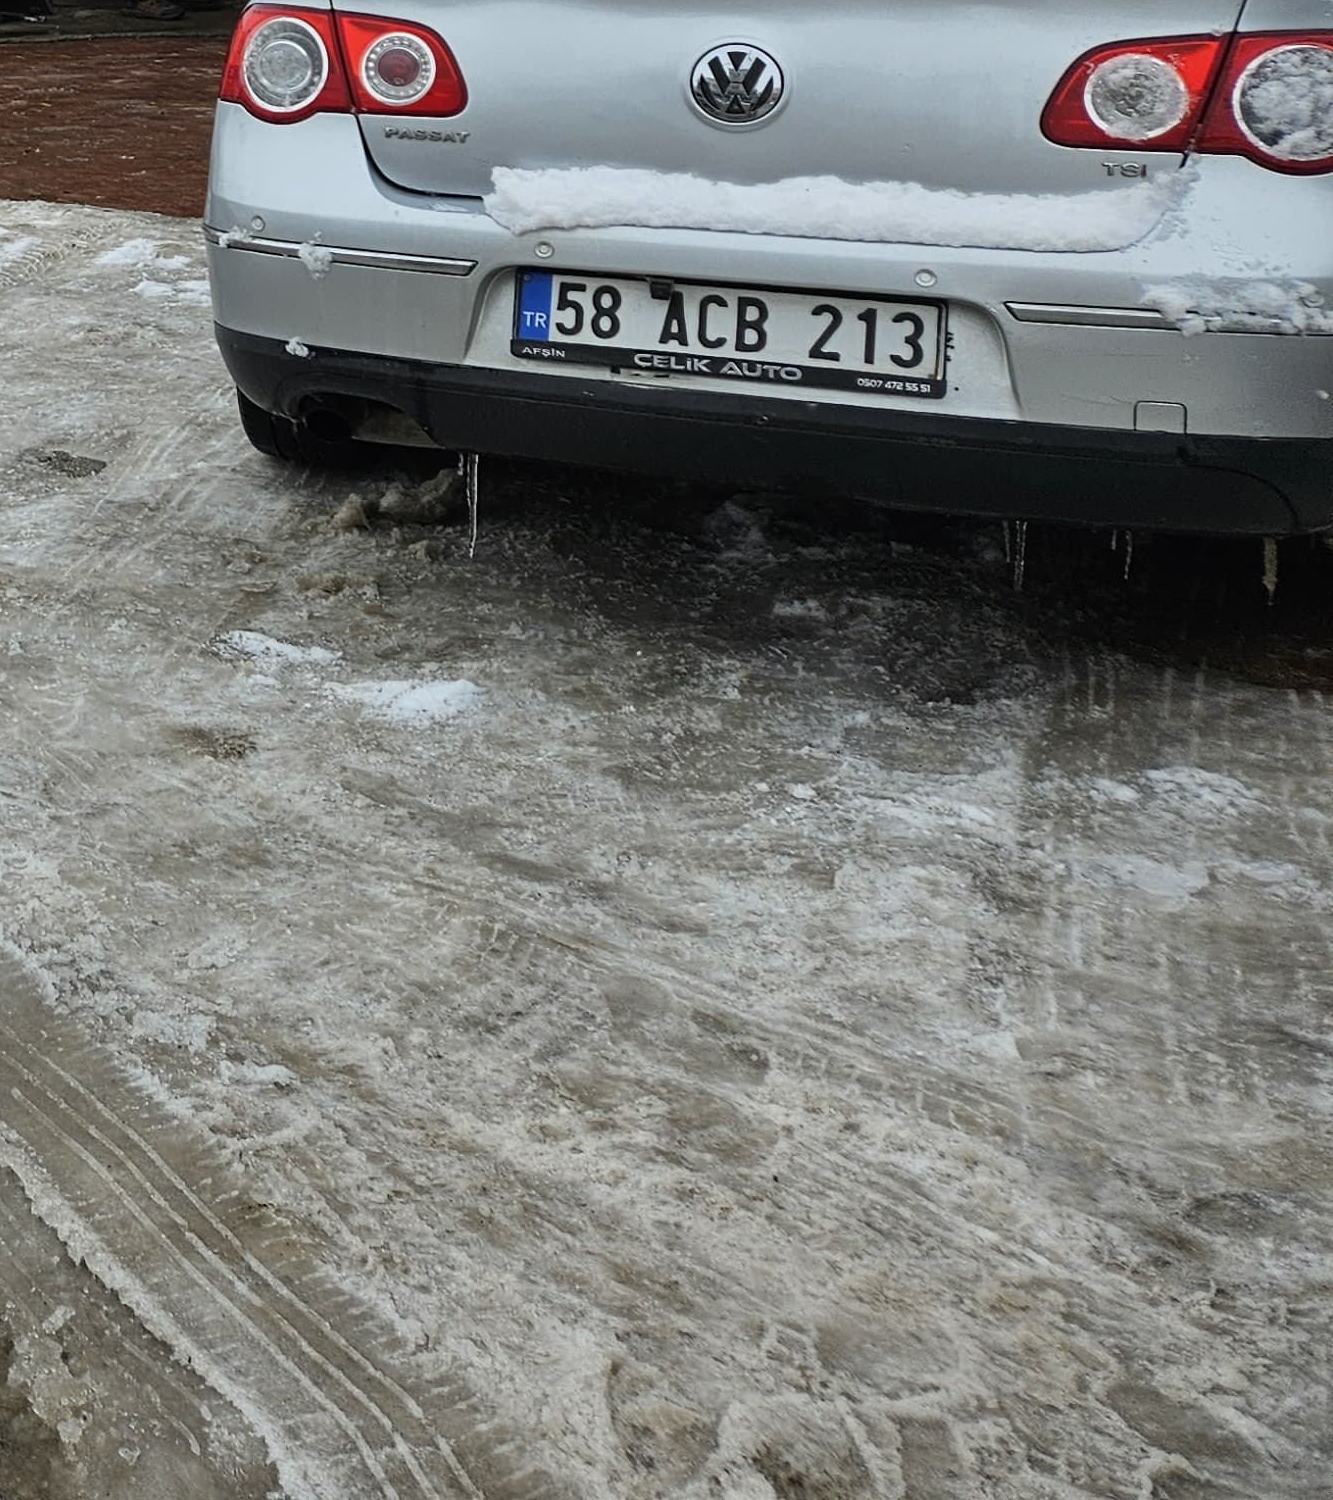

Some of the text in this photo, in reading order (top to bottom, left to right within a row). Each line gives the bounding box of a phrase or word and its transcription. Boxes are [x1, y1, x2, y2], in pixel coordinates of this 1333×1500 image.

[385, 126, 470, 143] PASSAT
[1101, 162, 1147, 177] TSI
[523, 311, 547, 328] TR
[556, 282, 924, 368] 58 ACB 213
[719, 361, 803, 380] AUTO
[857, 378, 883, 388] 0507
[884, 380, 904, 390] 472
